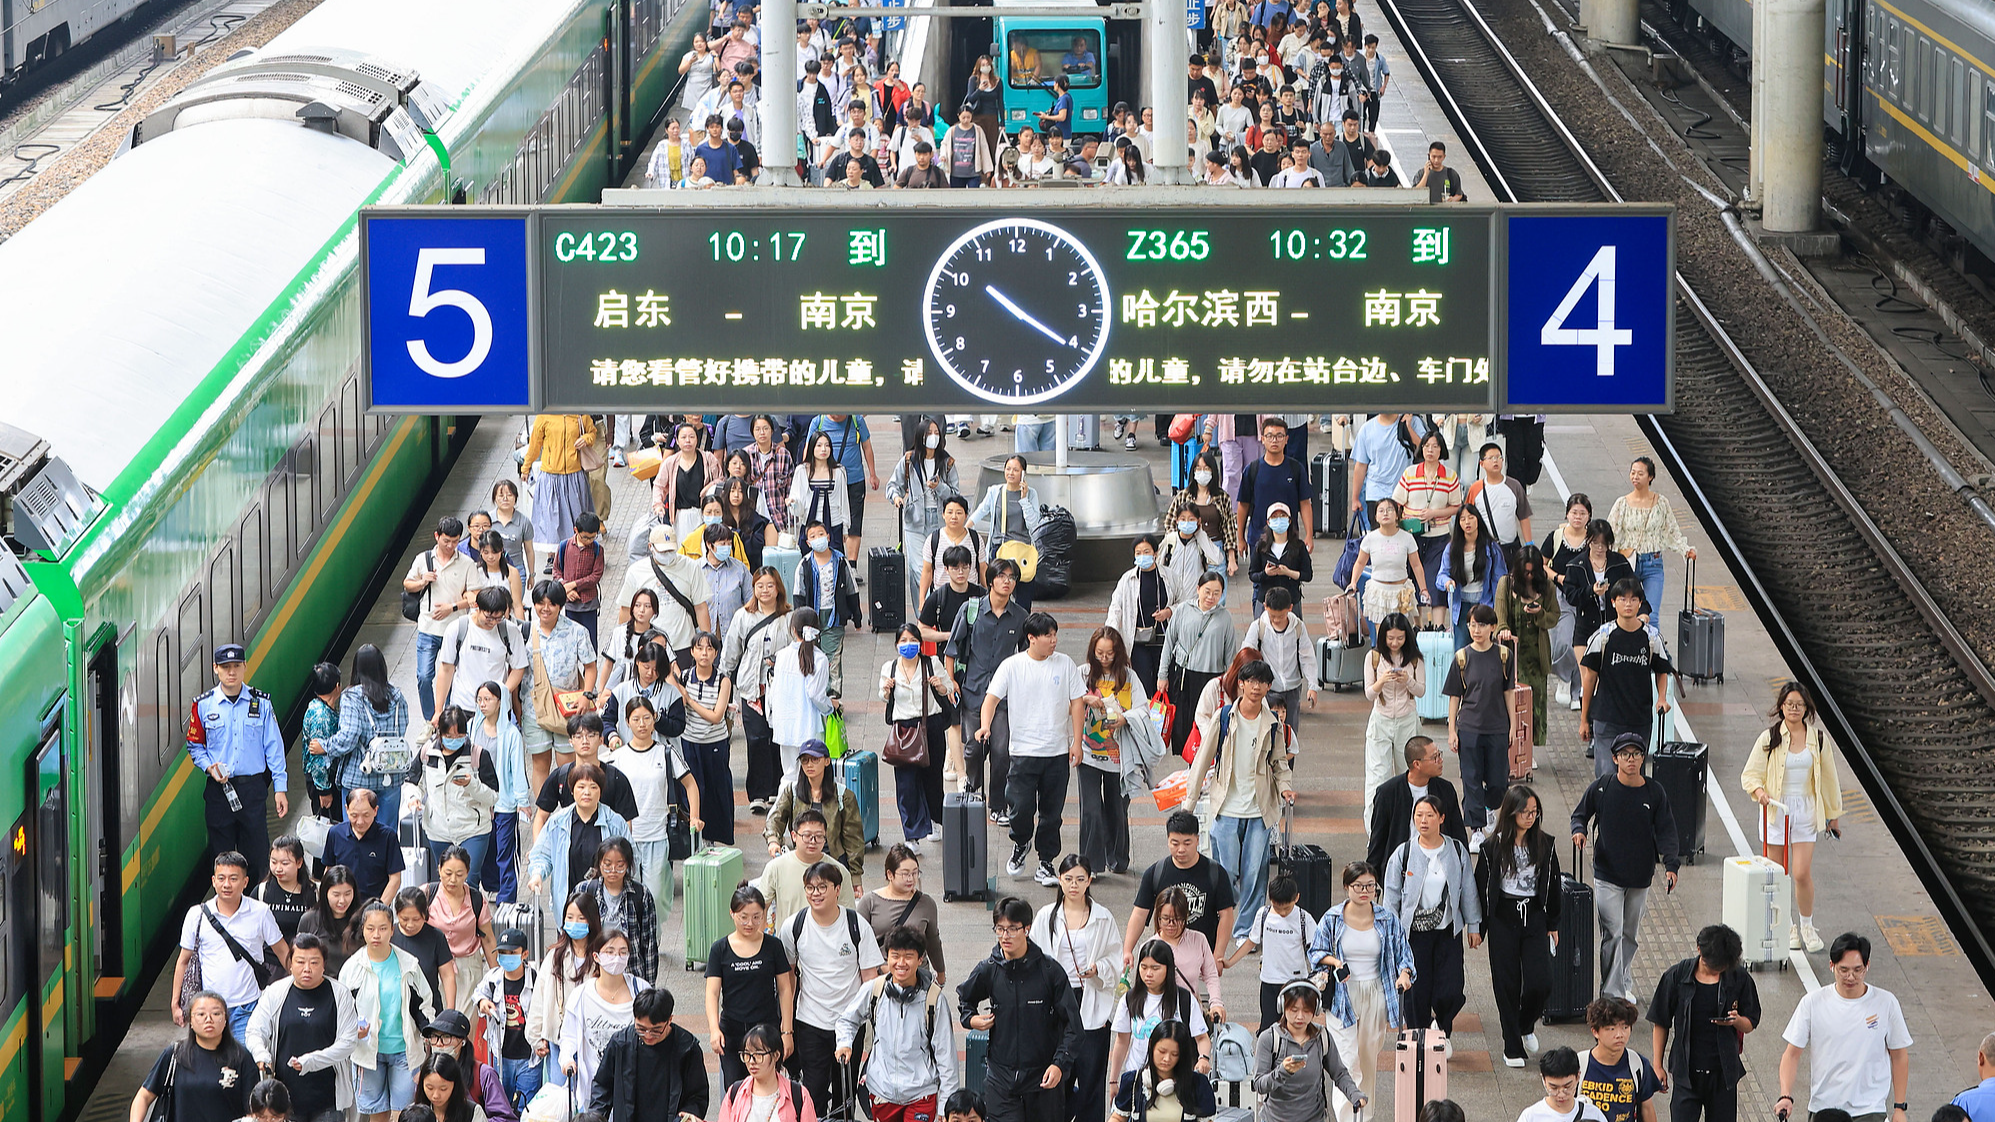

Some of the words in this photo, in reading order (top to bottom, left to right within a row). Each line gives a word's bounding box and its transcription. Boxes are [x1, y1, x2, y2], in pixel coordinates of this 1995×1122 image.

[555, 231, 638, 263] C423
[709, 231, 806, 262] 10:17
[848, 228, 886, 267] 到
[1008, 239, 1026, 253] 12
[1126, 230, 1210, 262] Z365
[1270, 229, 1367, 261] 10:32
[1412, 226, 1450, 266] 到
[975, 247, 992, 262] 11
[1045, 247, 1053, 262] 1
[952, 272, 969, 287] 10
[1068, 271, 1078, 286] 2
[406, 247, 493, 379] 5
[593, 288, 672, 329] 启东
[799, 290, 878, 331] 南京
[945, 304, 956, 318] 9
[1077, 303, 1088, 318] 3
[1122, 288, 1281, 329] 哈尔滨西
[1364, 287, 1443, 328] 南京
[1540, 245, 1633, 376] 4
[955, 336, 966, 351] 8
[1068, 335, 1078, 349] 4
[980, 359, 990, 374] 7
[1045, 359, 1055, 373] 5
[1013, 369, 1023, 383] 6
[1595, 1101, 1610, 1112] SO
